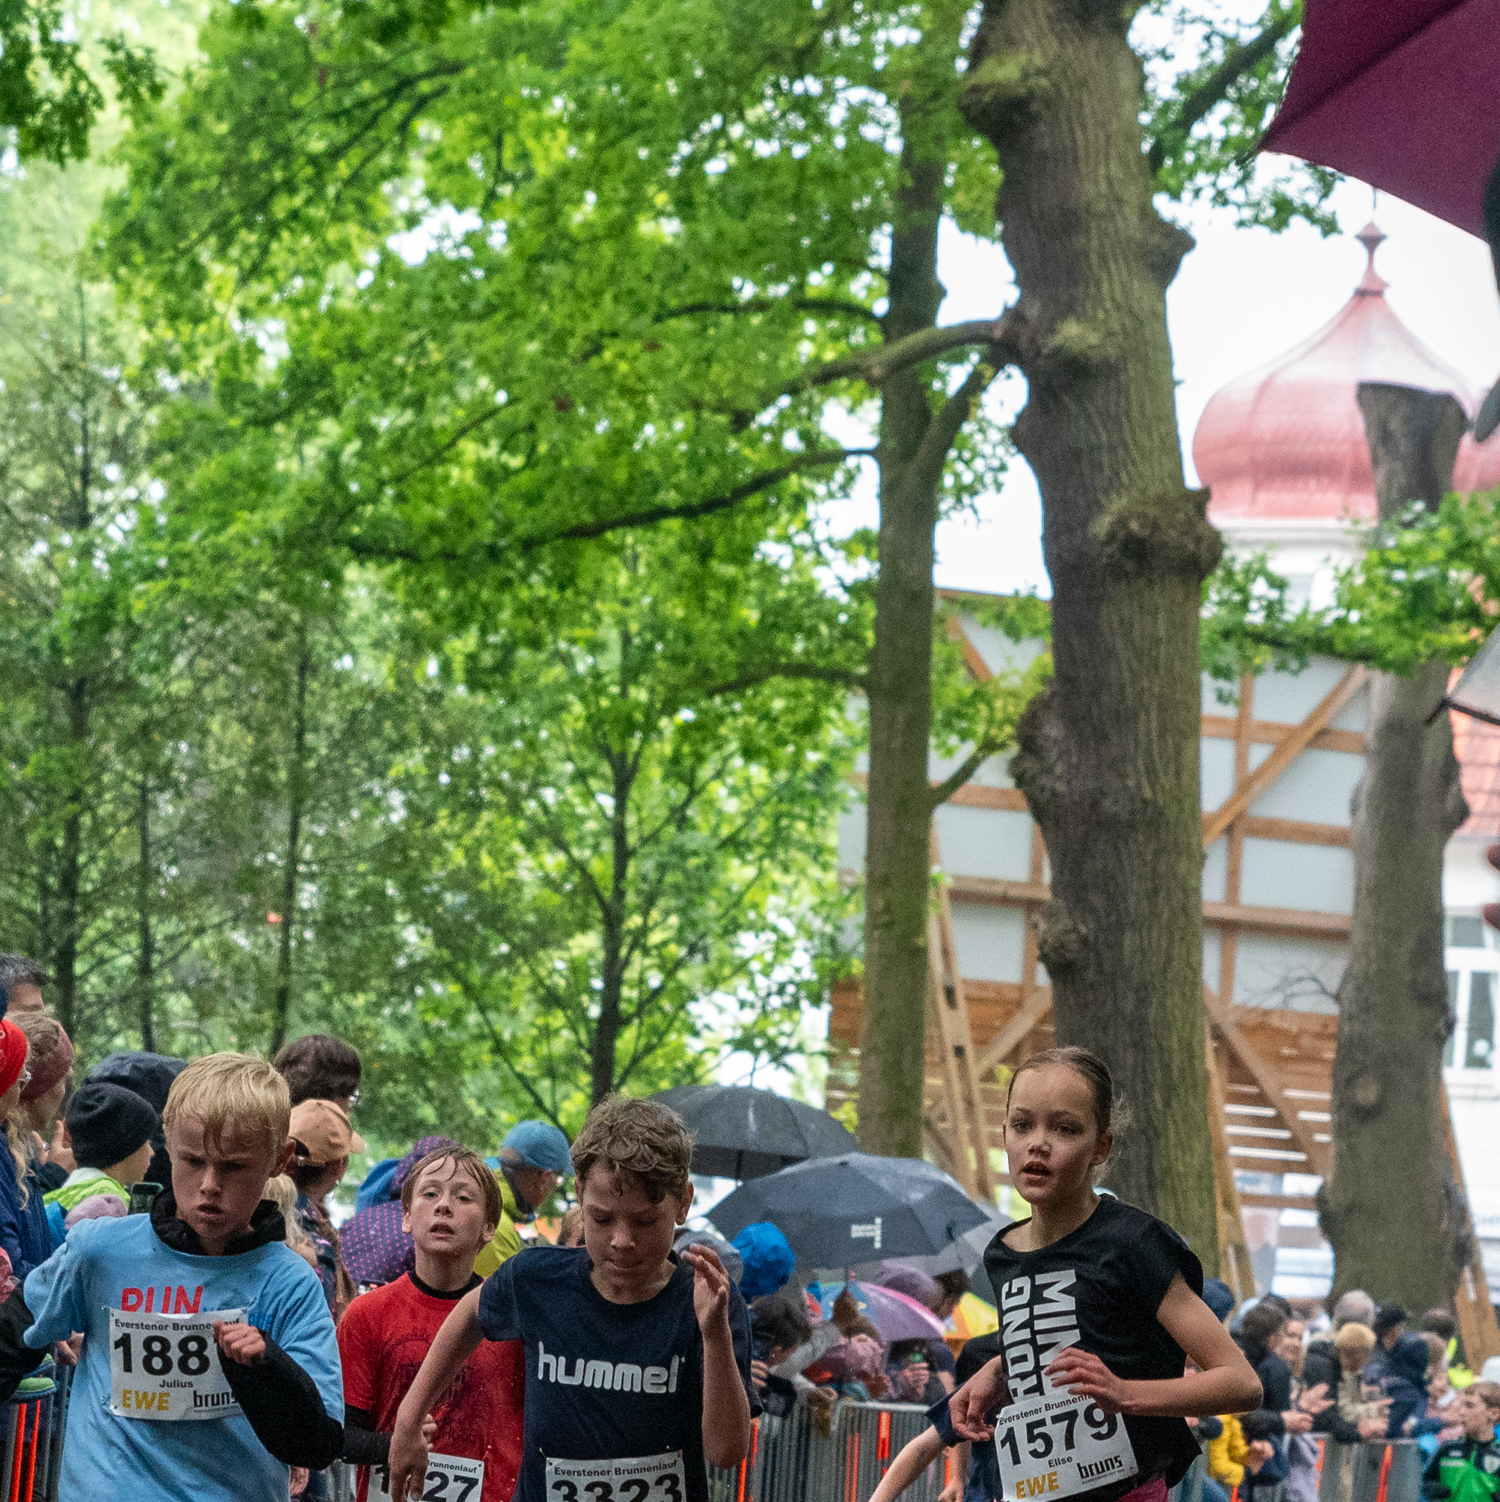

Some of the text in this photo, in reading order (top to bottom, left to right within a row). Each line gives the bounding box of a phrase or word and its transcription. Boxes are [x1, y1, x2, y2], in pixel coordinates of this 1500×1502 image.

[114, 1318, 169, 1331] Everstener
[1001, 1275, 1041, 1404] RONG
[113, 1333, 219, 1376] 188
[537, 1340, 680, 1394] hummel
[159, 1379, 194, 1389] Julius
[122, 1389, 170, 1411] EWE
[999, 1406, 1043, 1426] Everstener
[1000, 1403, 1119, 1467] 1579
[427, 1460, 478, 1474] runnenlauf
[554, 1460, 677, 1477] Everstener Brunnenlauf
[1048, 1456, 1073, 1468] Elise
[1076, 1455, 1123, 1479] bruns
[1015, 1471, 1060, 1499] EWE
